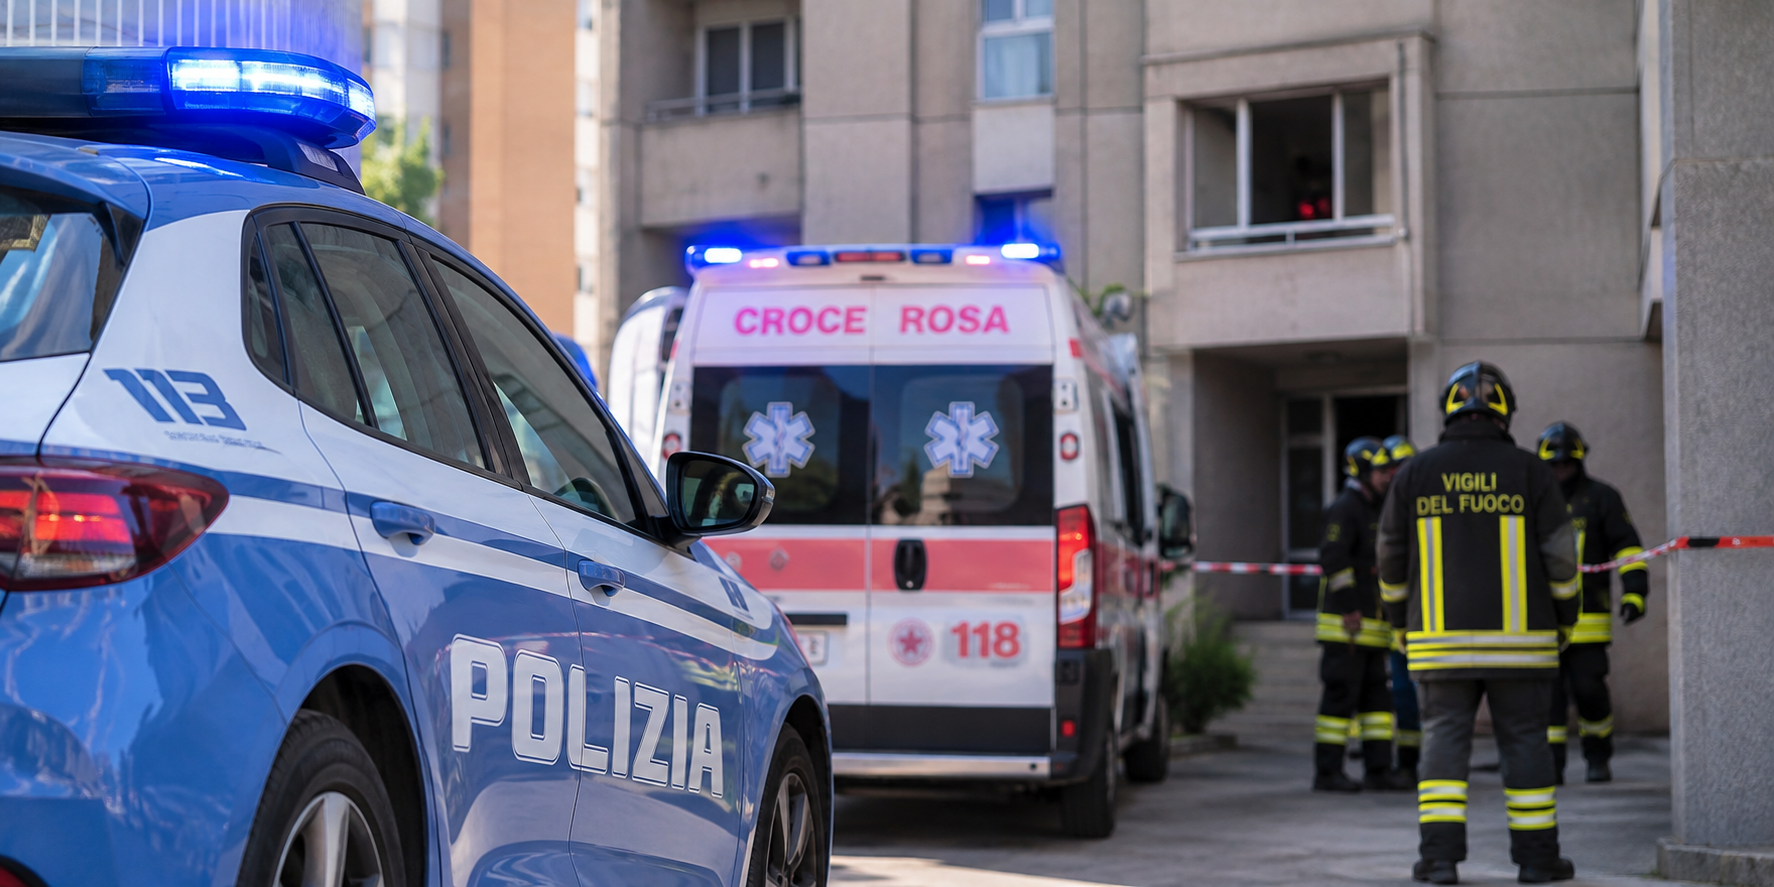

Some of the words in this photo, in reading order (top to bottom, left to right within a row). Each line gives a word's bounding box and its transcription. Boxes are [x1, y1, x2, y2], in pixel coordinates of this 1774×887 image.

[734, 305, 867, 335] CROCE
[900, 304, 1010, 334] ROSA
[102, 368, 247, 431] 113
[1441, 472, 1497, 492] VIGILI
[1416, 495, 1454, 516] DEL
[1458, 494, 1525, 514] FUOCO
[951, 620, 1022, 660] 118
[451, 633, 724, 798] POLIZIA
